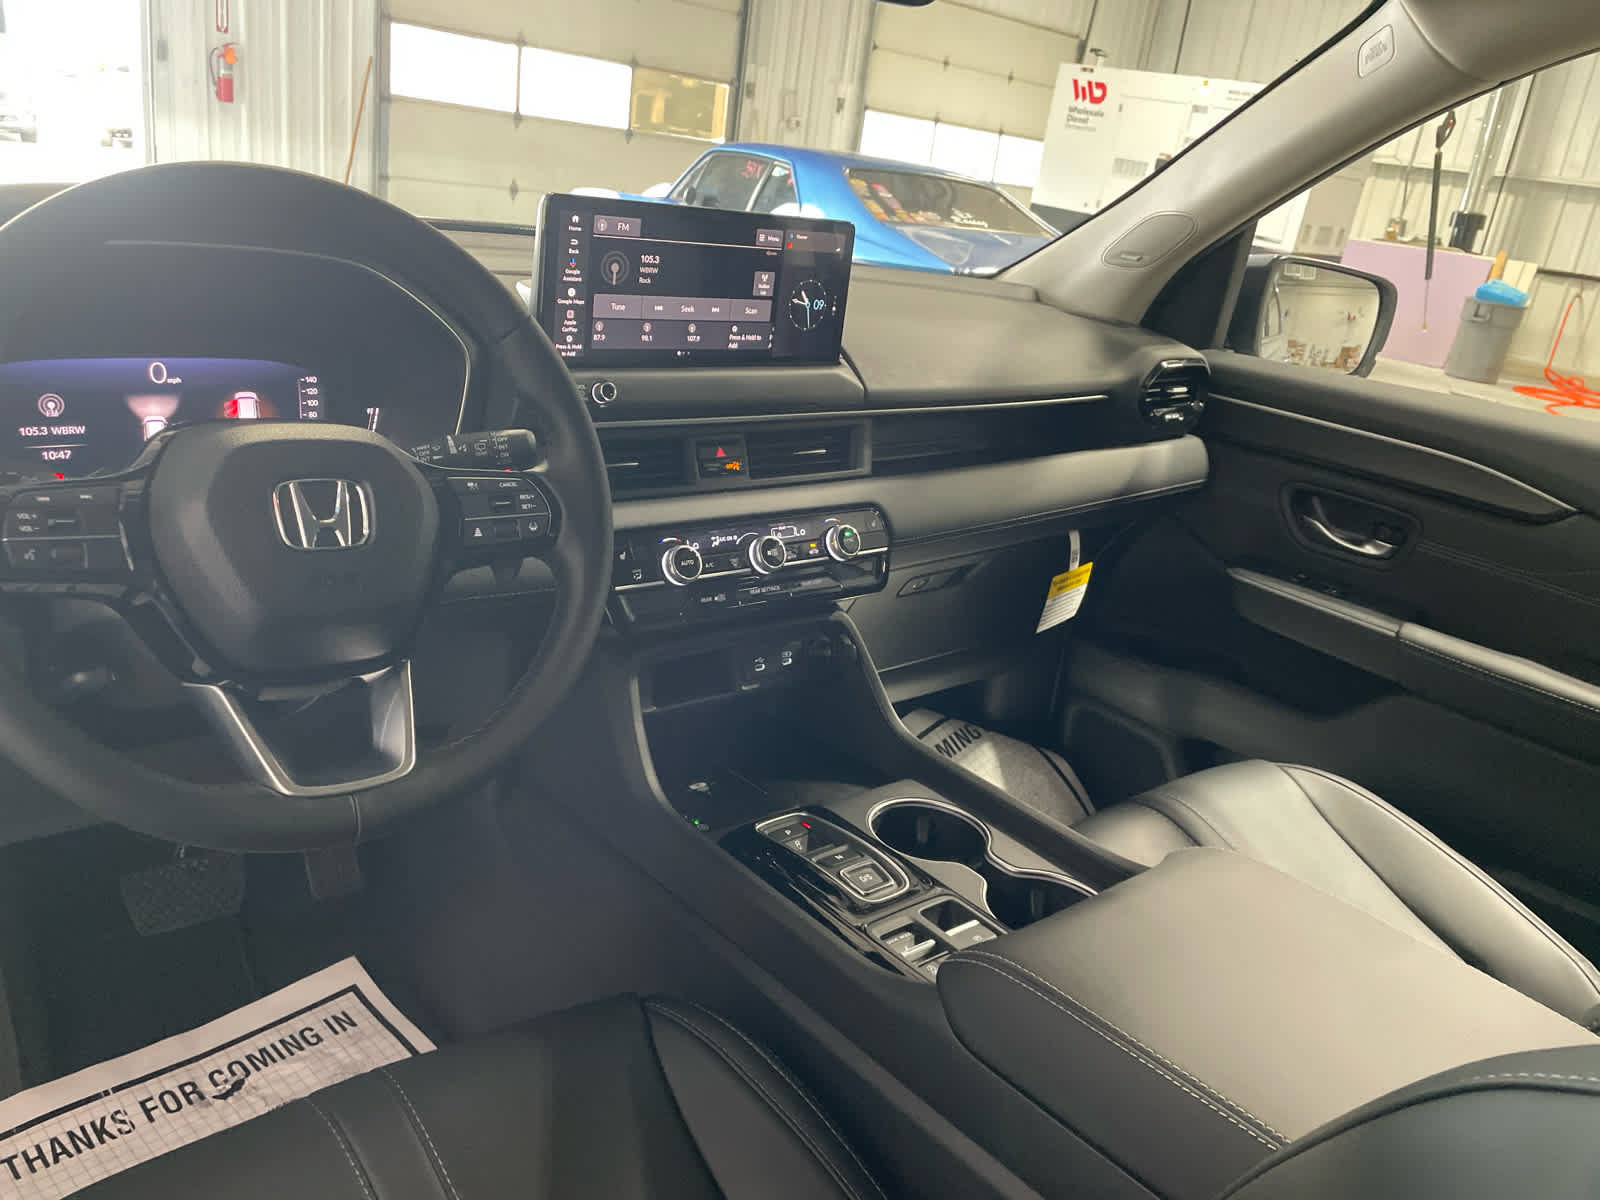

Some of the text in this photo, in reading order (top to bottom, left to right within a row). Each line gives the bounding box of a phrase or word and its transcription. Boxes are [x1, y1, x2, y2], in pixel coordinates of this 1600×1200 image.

[617, 222, 630, 231] FM
[640, 254, 660, 264] 105.3
[611, 302, 626, 312] Tune
[680, 305, 695, 313] Seek
[813, 299, 825, 310] 09
[306, 399, 319, 407] 100
[18, 425, 86, 437] 105.3 WBRW
[42, 450, 72, 460] 10:47
[0, 1010, 359, 1181] THANKS FOR COMING IN
